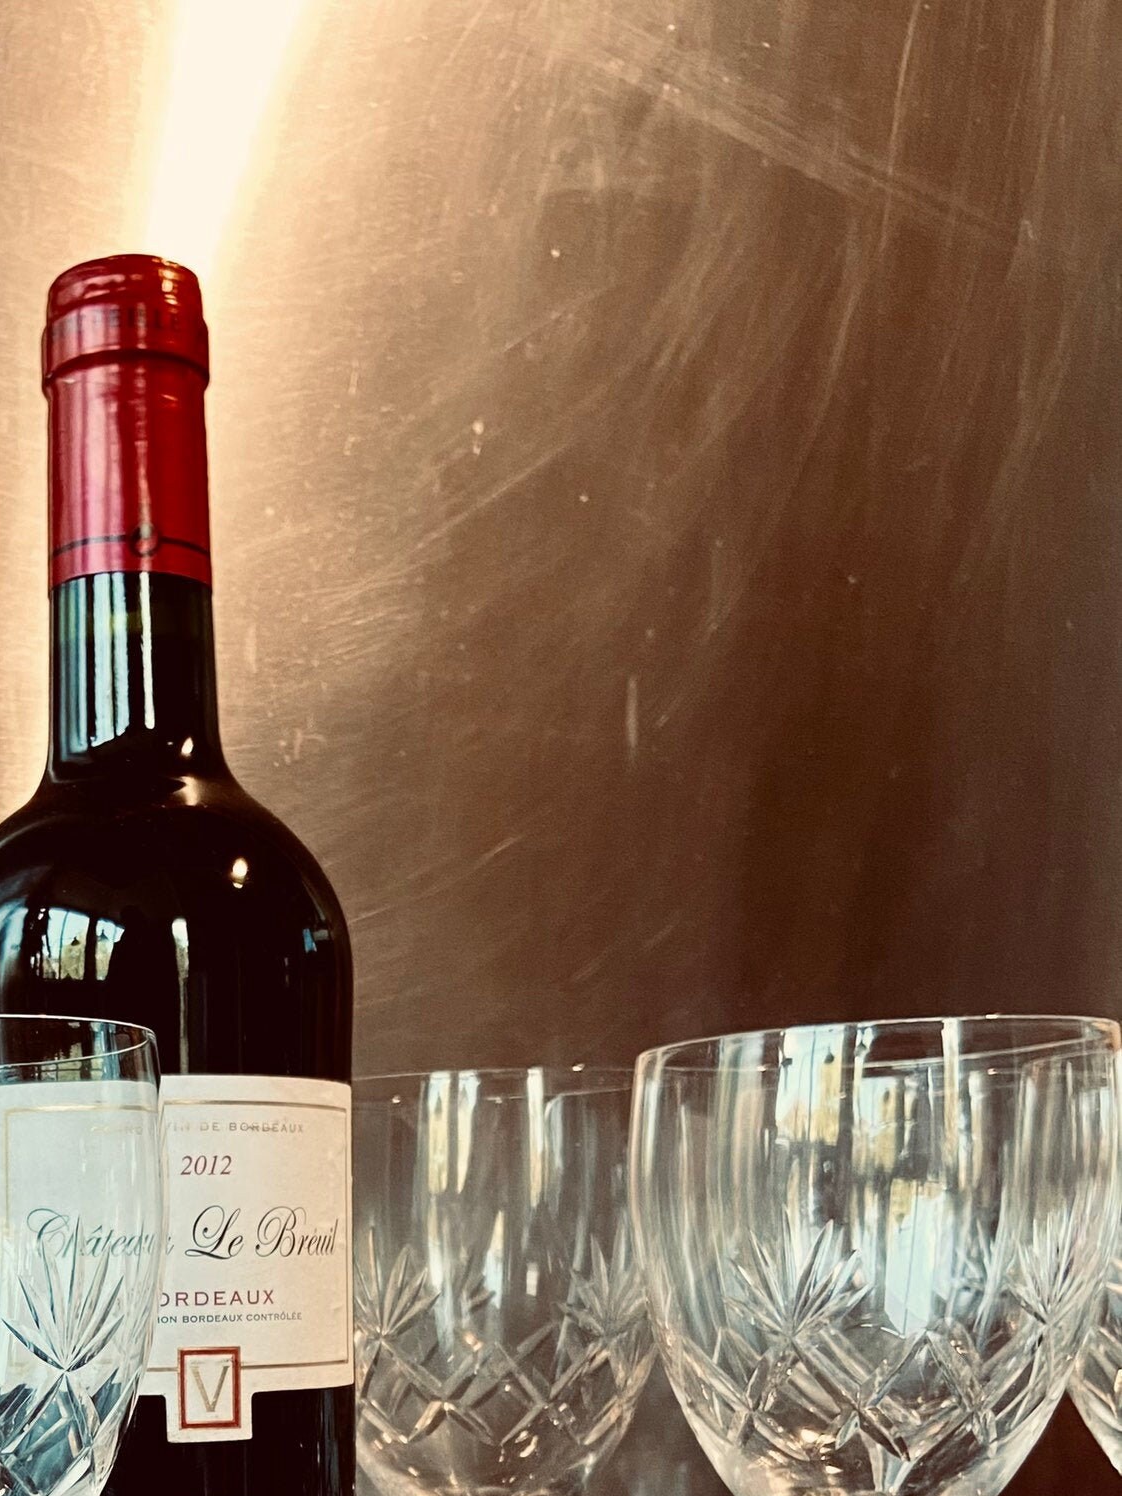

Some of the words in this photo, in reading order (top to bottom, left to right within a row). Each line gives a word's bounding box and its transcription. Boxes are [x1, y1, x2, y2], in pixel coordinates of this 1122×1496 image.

[229, 1121, 305, 1134] BORDEAUX
[180, 1155, 233, 1176] 2012
[184, 1205, 246, 1260] Le
[159, 1289, 275, 1307] ORDEAUX
[181, 1314, 243, 1324] BORDEAUX
[245, 1311, 303, 1323] CONTRÔLÉE
[189, 1361, 232, 1413] V
